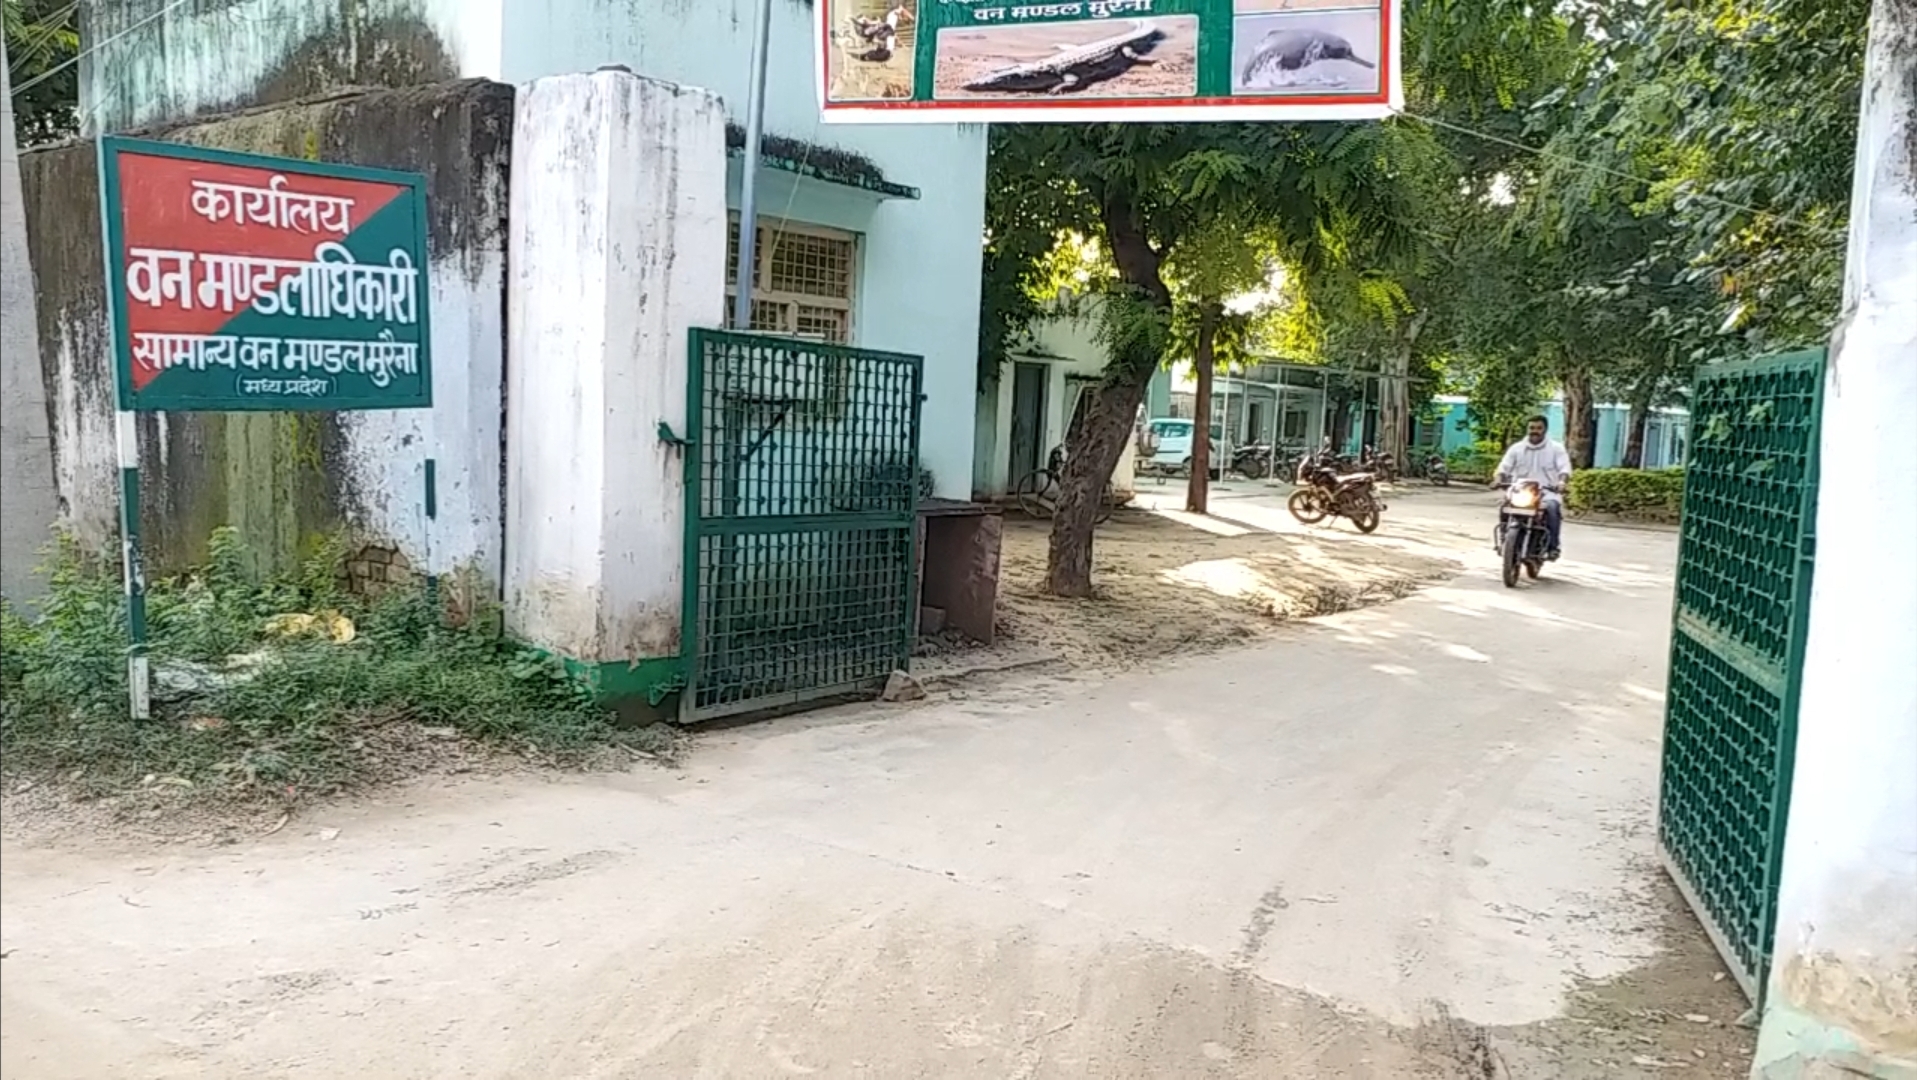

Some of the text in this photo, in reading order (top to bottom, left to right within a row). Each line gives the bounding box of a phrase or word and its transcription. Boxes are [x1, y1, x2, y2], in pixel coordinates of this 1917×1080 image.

[974, 8, 1004, 21] वन
[1011, 2, 1081, 19] मण्डल
[191, 175, 355, 234] कार्यालय
[127, 241, 419, 324] वन मण्डलाधिकारी
[132, 332, 239, 370] सामान्य
[239, 336, 281, 371] वन
